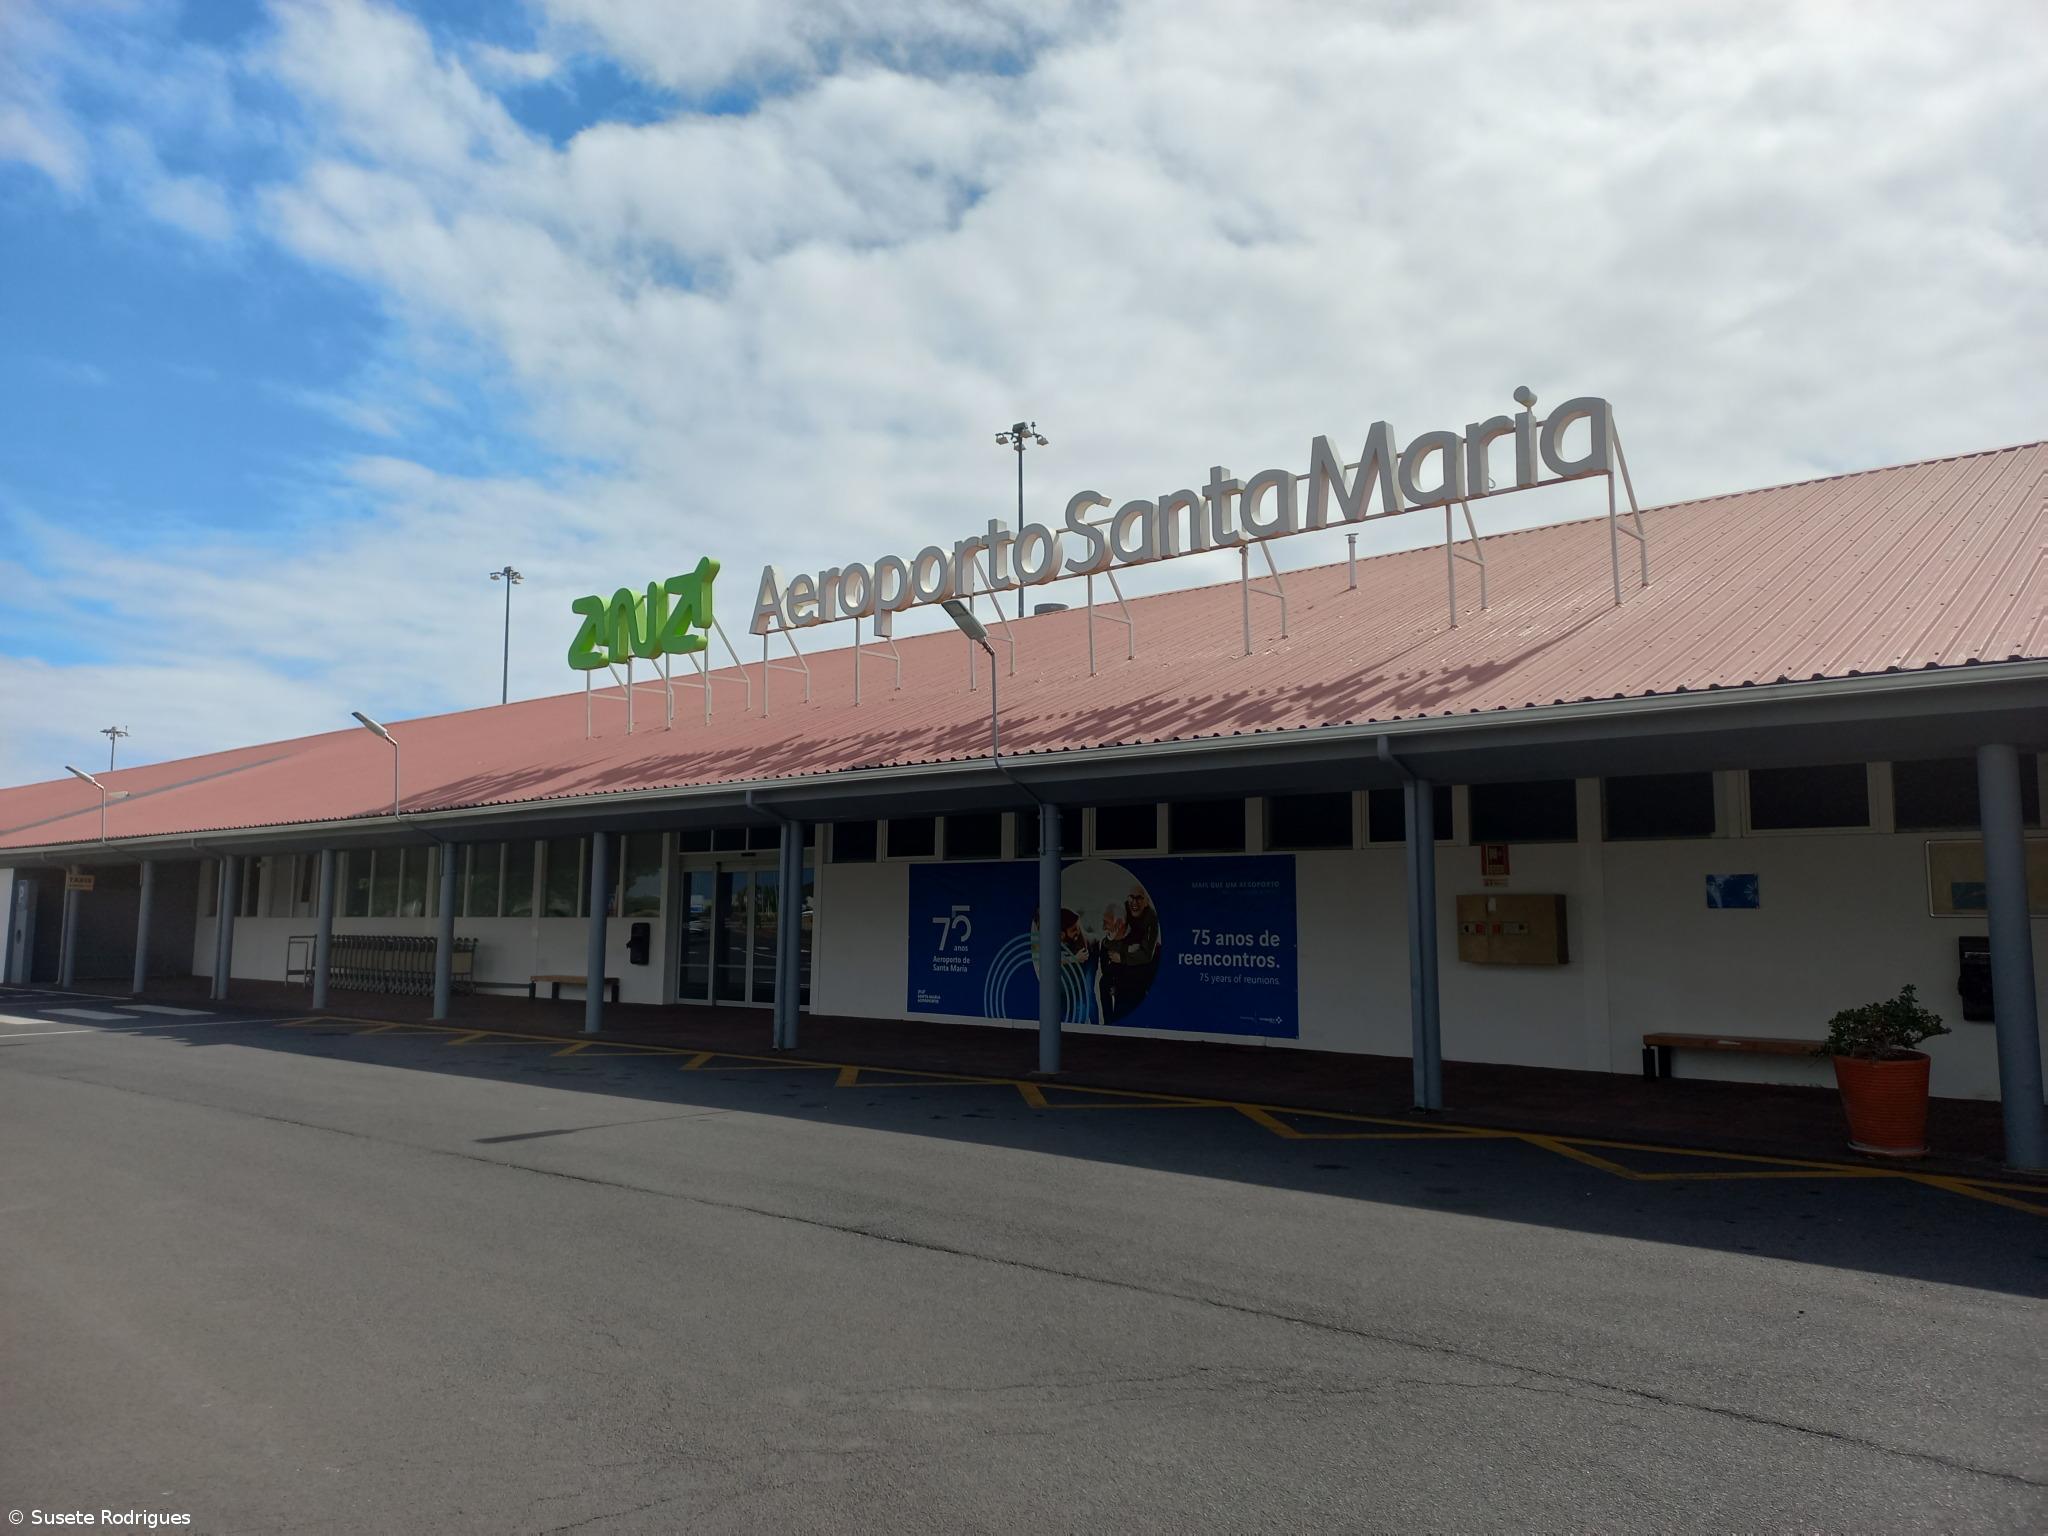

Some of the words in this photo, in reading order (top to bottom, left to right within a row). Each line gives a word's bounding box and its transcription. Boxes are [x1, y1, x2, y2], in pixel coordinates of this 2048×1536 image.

[932, 905, 972, 951] 75
[1192, 929, 1211, 945] 75
[1215, 933, 1254, 946] anos
[1259, 929, 1280, 947] de
[932, 955, 961, 965] Aeroporto
[962, 956, 971, 964] de
[1178, 952, 1280, 969] reencontros.
[932, 963, 949, 972] Santa
[950, 964, 968, 973] Maria
[1199, 972, 1209, 982] 75
[1211, 975, 1232, 985] years
[1233, 974, 1242, 983] of
